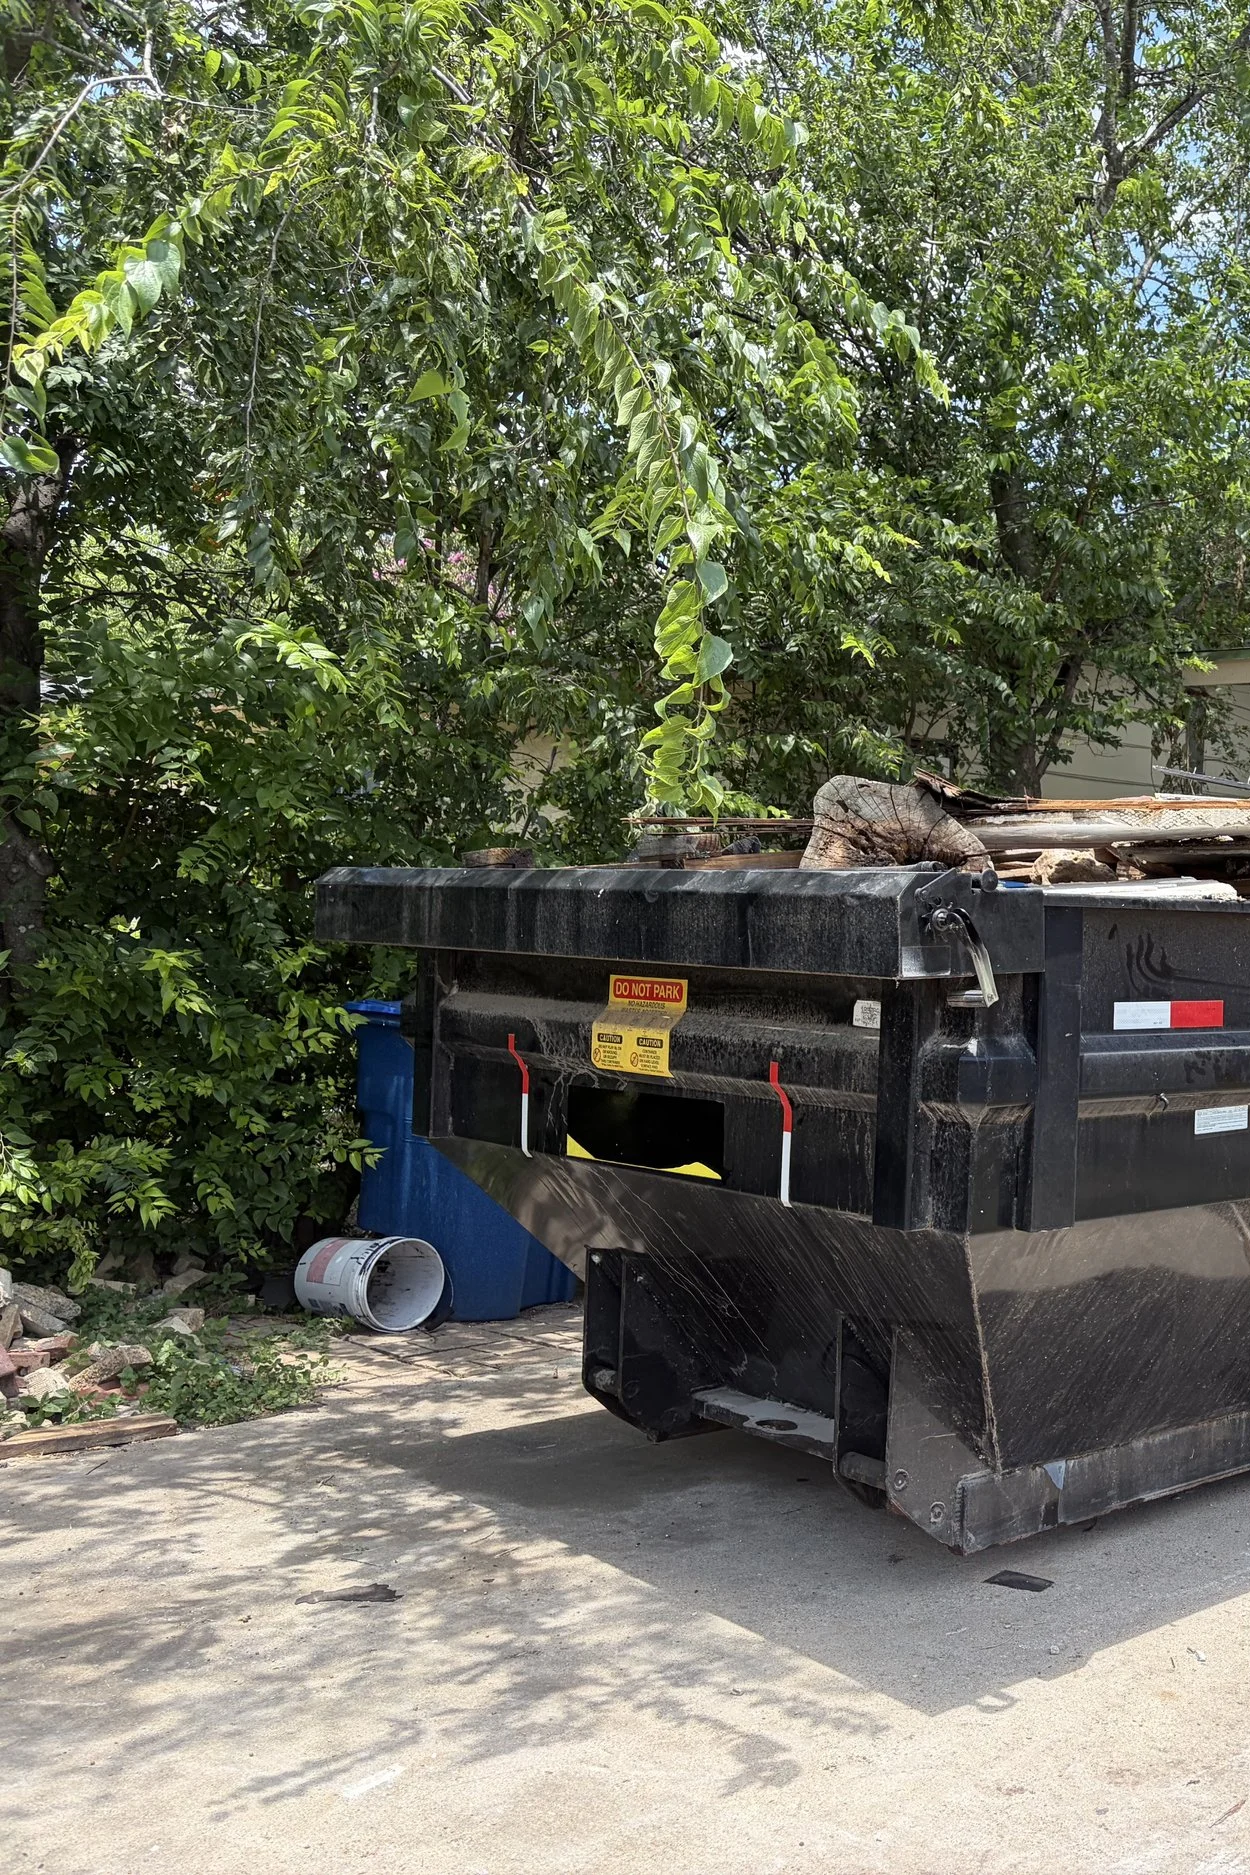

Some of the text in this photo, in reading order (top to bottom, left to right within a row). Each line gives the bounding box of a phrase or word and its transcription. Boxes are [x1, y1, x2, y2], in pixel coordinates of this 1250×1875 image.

[615, 981, 680, 1000] DO NOT PARK
[599, 1034, 621, 1043] CAUTION
[638, 1038, 662, 1048] CAUTION
